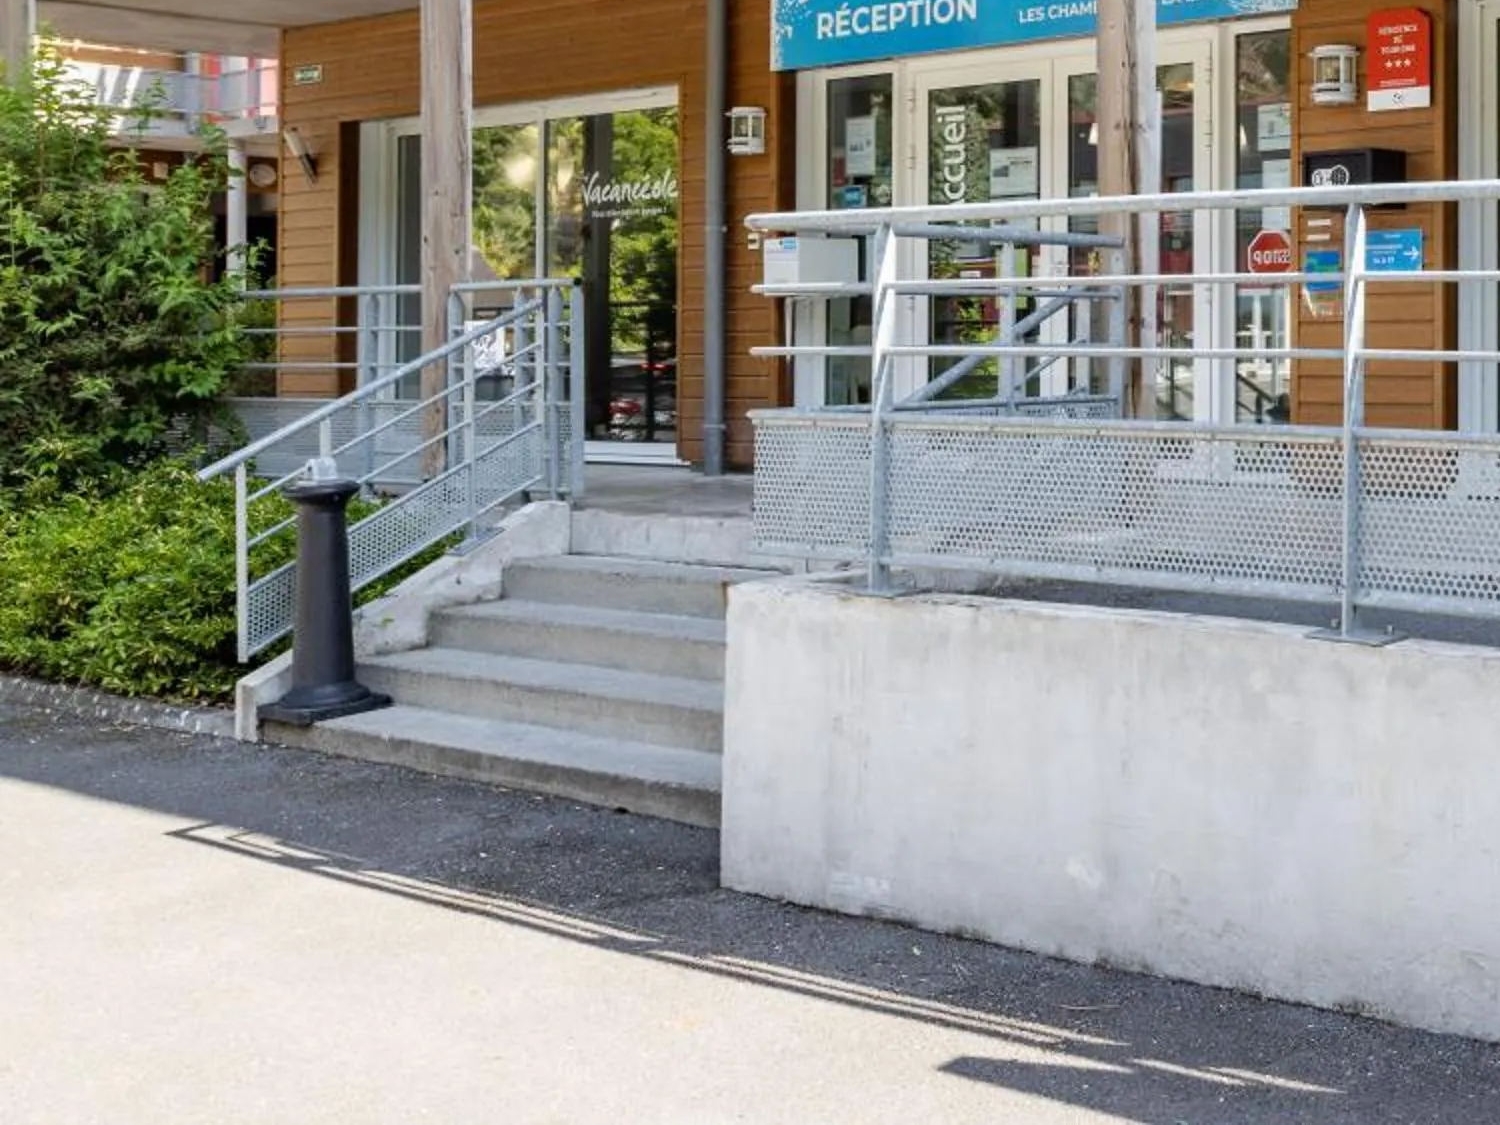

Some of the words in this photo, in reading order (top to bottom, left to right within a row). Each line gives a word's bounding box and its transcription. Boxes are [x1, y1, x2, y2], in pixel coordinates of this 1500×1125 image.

[1018, 6, 1044, 23] LES
[1047, 0, 1099, 20] CHAM
[935, 105, 966, 206] ccueil
